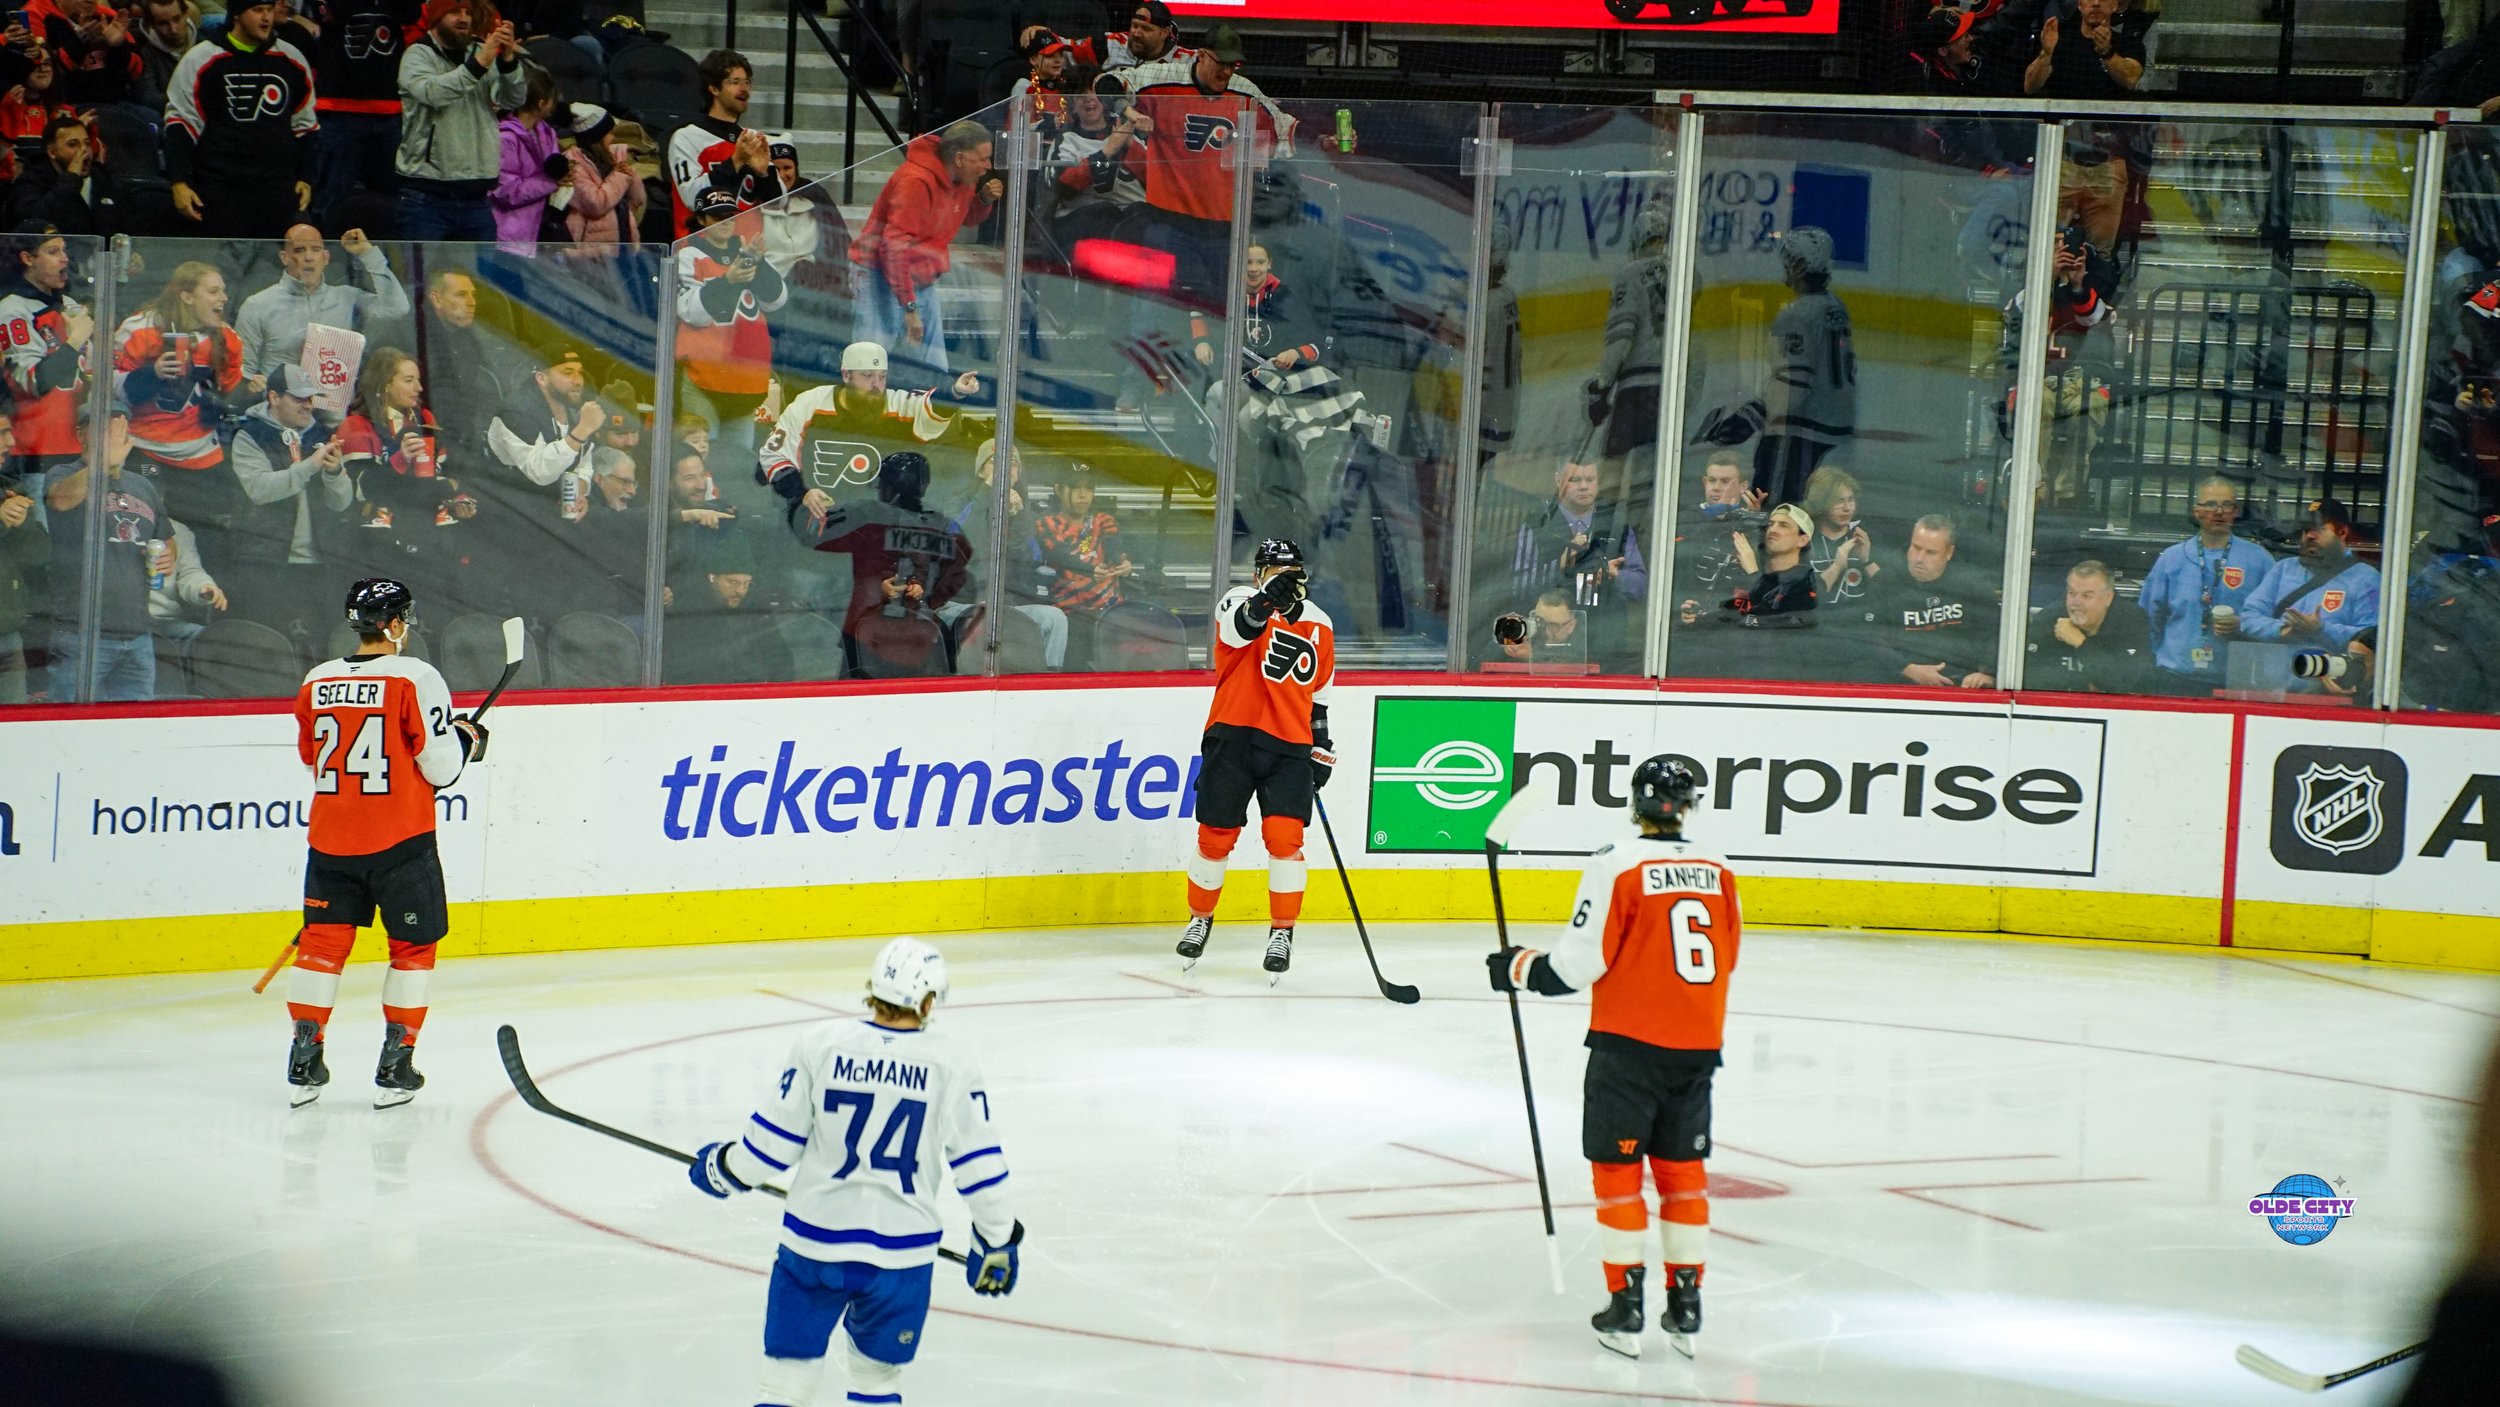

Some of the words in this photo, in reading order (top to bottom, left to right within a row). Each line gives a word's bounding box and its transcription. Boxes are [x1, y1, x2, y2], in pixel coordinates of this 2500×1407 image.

[675, 160, 691, 185] 11
[320, 360, 341, 373] POP
[1904, 604, 1963, 625] FLYERS
[1309, 625, 1320, 645] A
[318, 683, 379, 706] SEELER
[312, 712, 391, 796] 24
[660, 738, 1202, 841] ticketmaster
[2314, 788, 2366, 832] NHL
[1573, 899, 1591, 928] 6
[1669, 898, 1717, 985] 6
[833, 1055, 928, 1092] McMANN
[823, 1088, 928, 1195] 74
